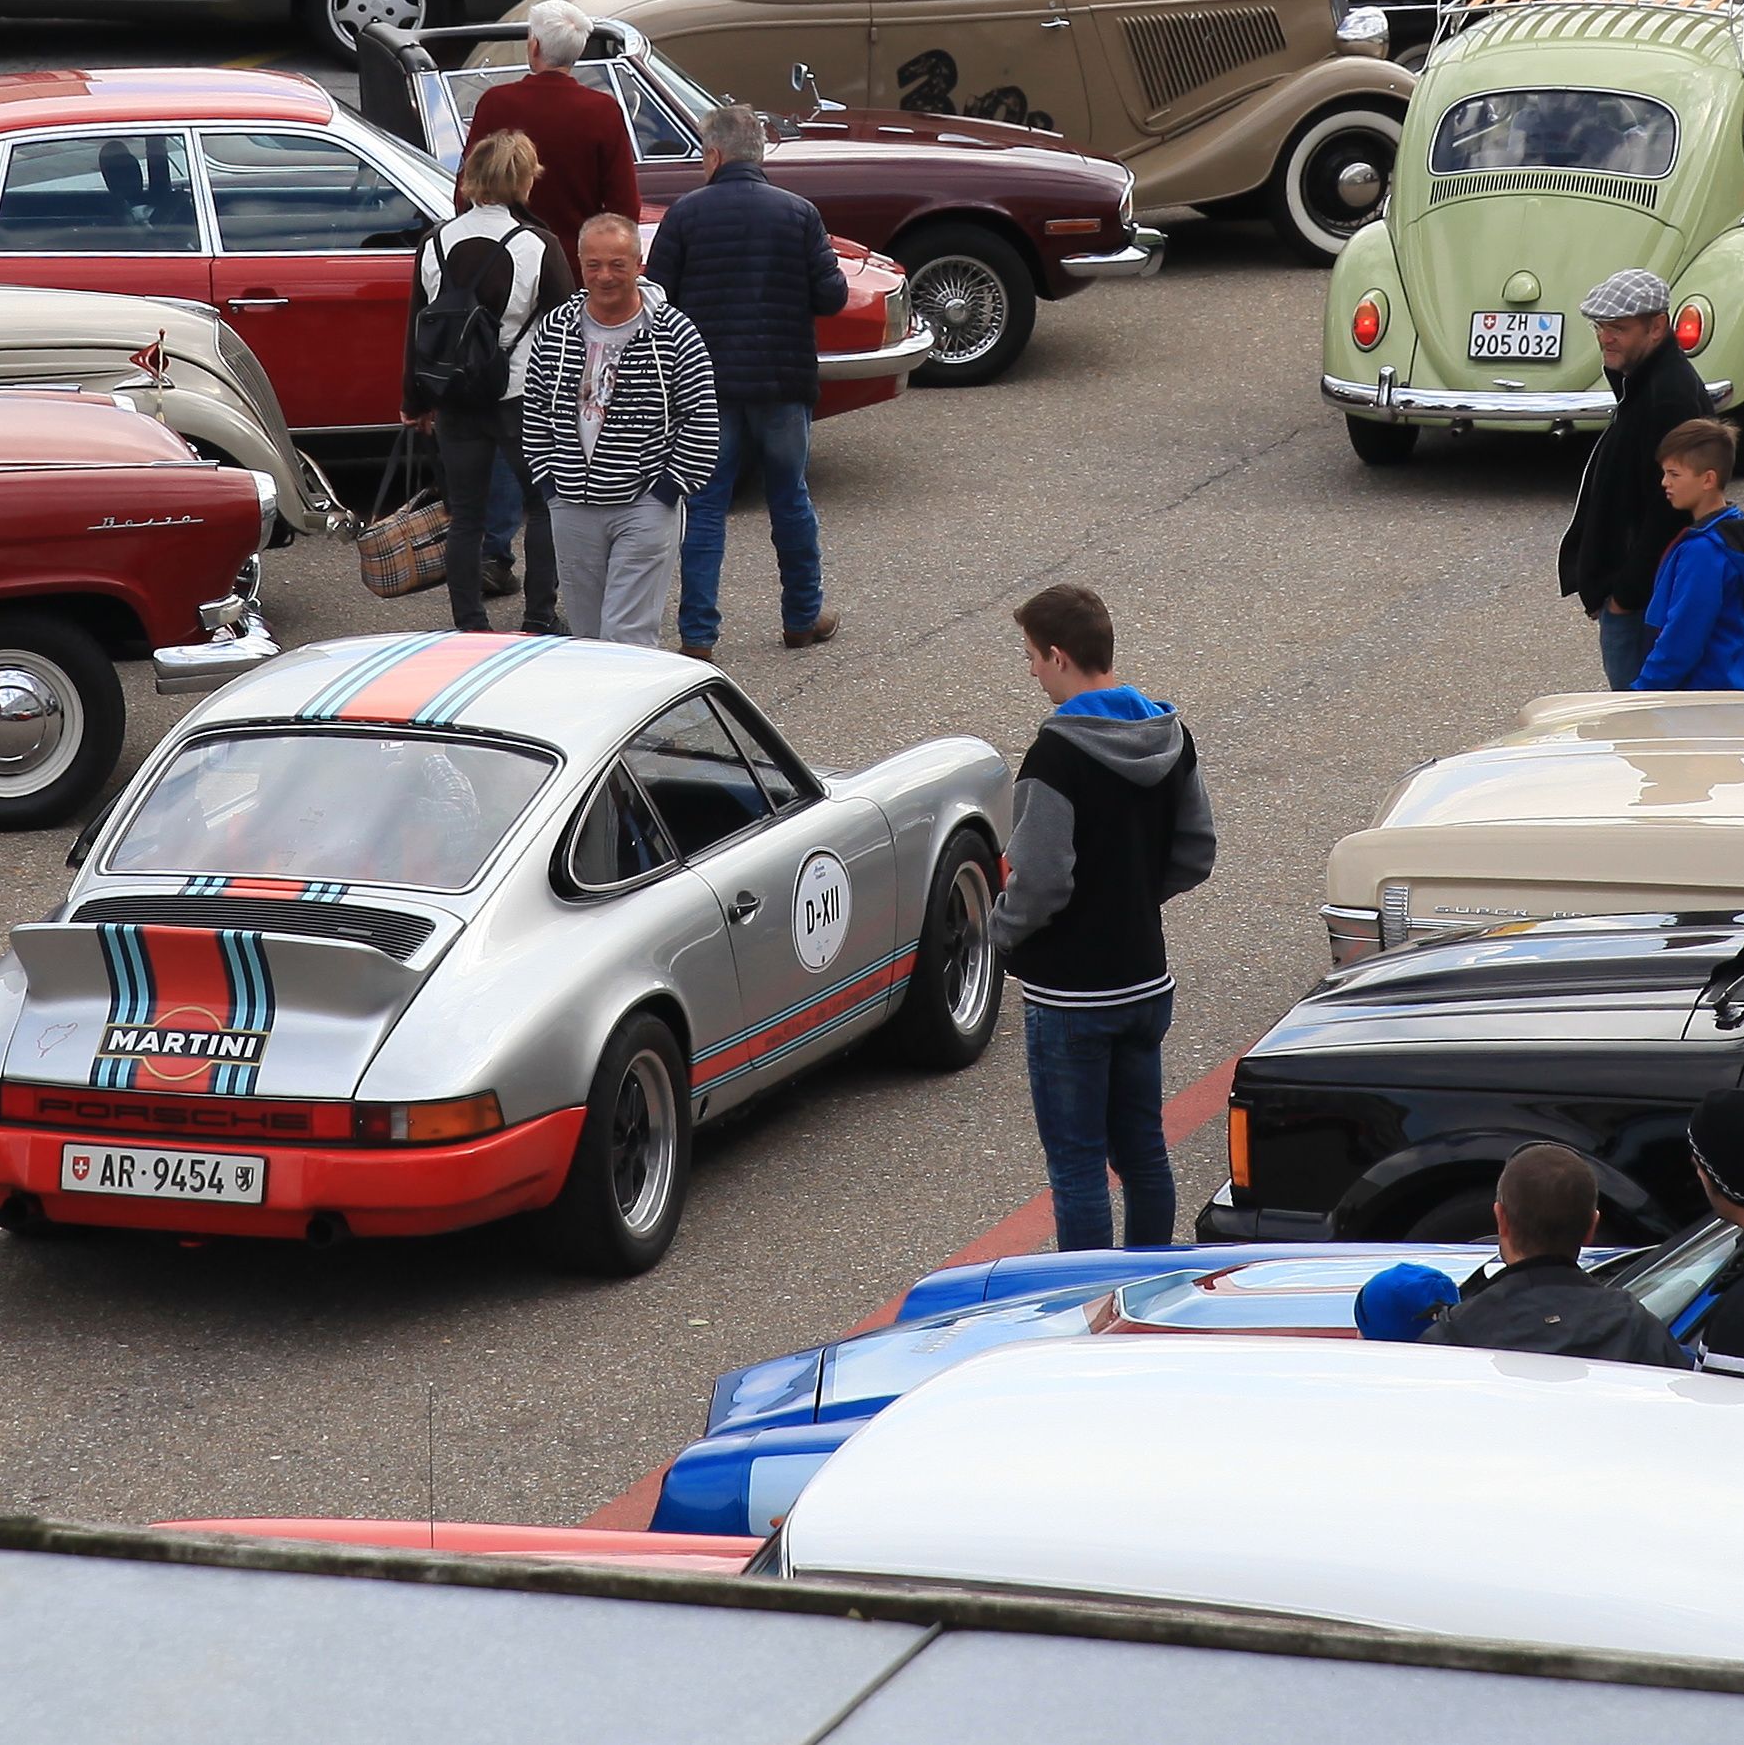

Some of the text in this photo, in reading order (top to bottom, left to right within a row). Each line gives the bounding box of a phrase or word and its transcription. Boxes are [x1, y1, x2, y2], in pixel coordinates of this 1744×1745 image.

[1506, 314, 1529, 331] ZH
[1474, 334, 1558, 356] 905 032
[805, 884, 840, 936] D-XII
[107, 1029, 258, 1059] MARTINI
[37, 1098, 310, 1131] PORSCHE
[99, 1153, 225, 1194] AR 9454
